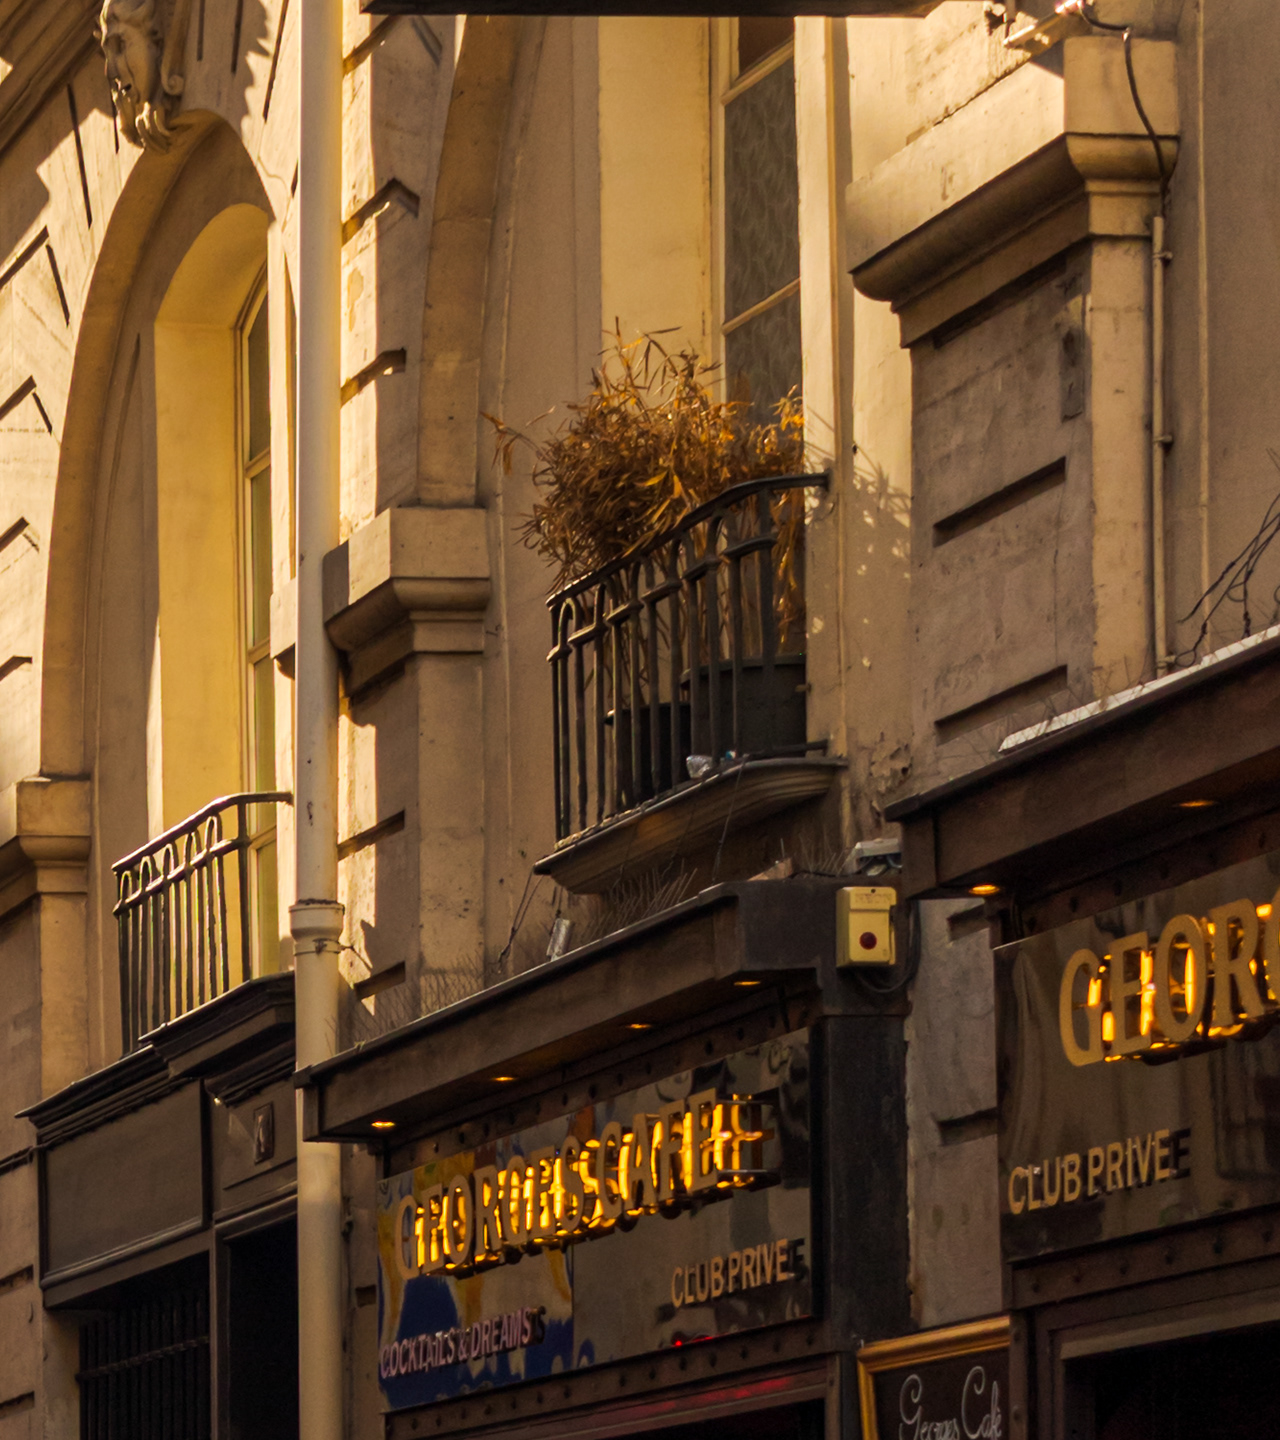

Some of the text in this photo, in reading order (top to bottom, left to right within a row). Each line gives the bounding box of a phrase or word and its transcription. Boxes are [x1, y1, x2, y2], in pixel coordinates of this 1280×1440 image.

[393, 1134, 586, 1282] GEORGES
[1008, 1128, 1172, 1216] CLUB PRIVE
[670, 1237, 789, 1309] CLUB PRIVE
[379, 1327, 456, 1380] COCKTAILS
[470, 1304, 535, 1351] DREAMS
